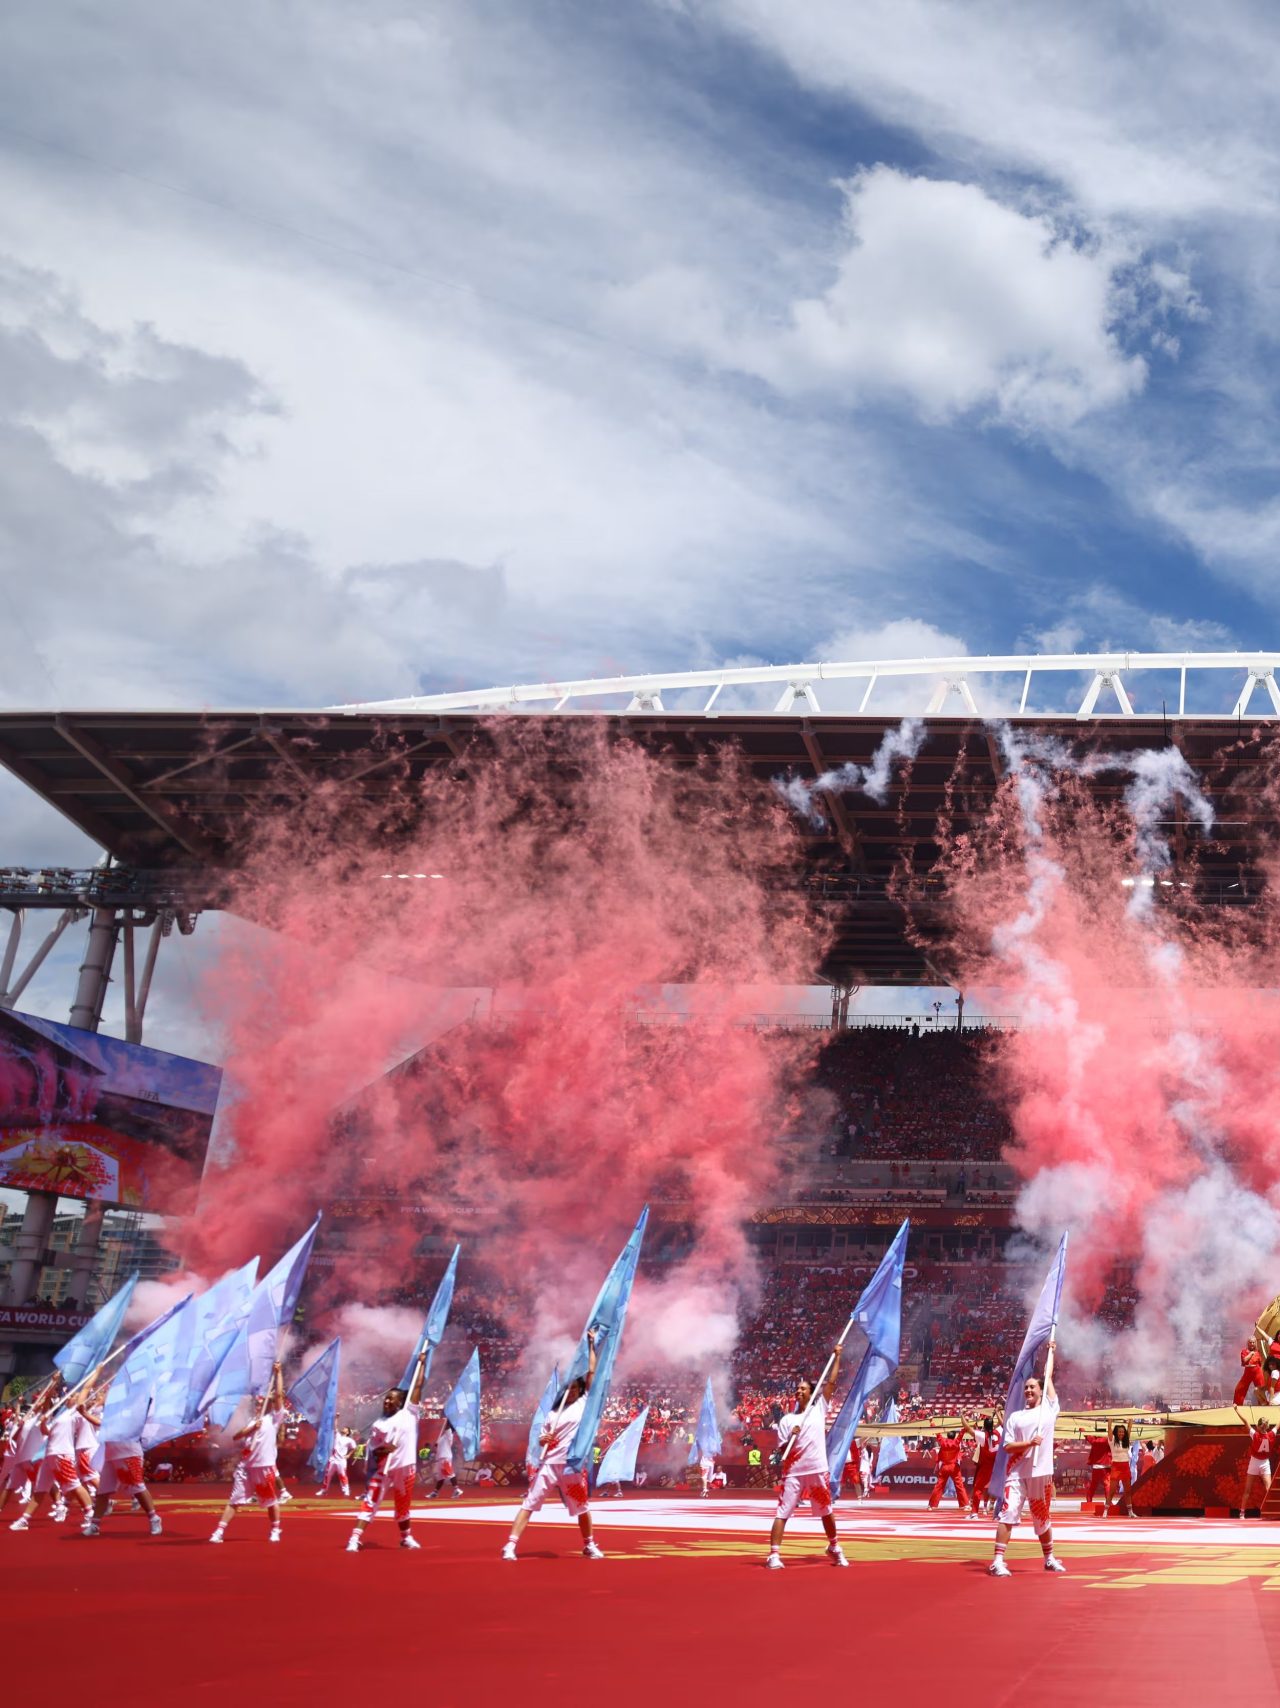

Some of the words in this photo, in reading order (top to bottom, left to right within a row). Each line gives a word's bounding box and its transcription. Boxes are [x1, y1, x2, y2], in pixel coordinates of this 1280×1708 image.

[15, 1312, 66, 1325] WORLD
[1258, 1438, 1270, 1453] A
[894, 1475, 938, 1484] WORLD
